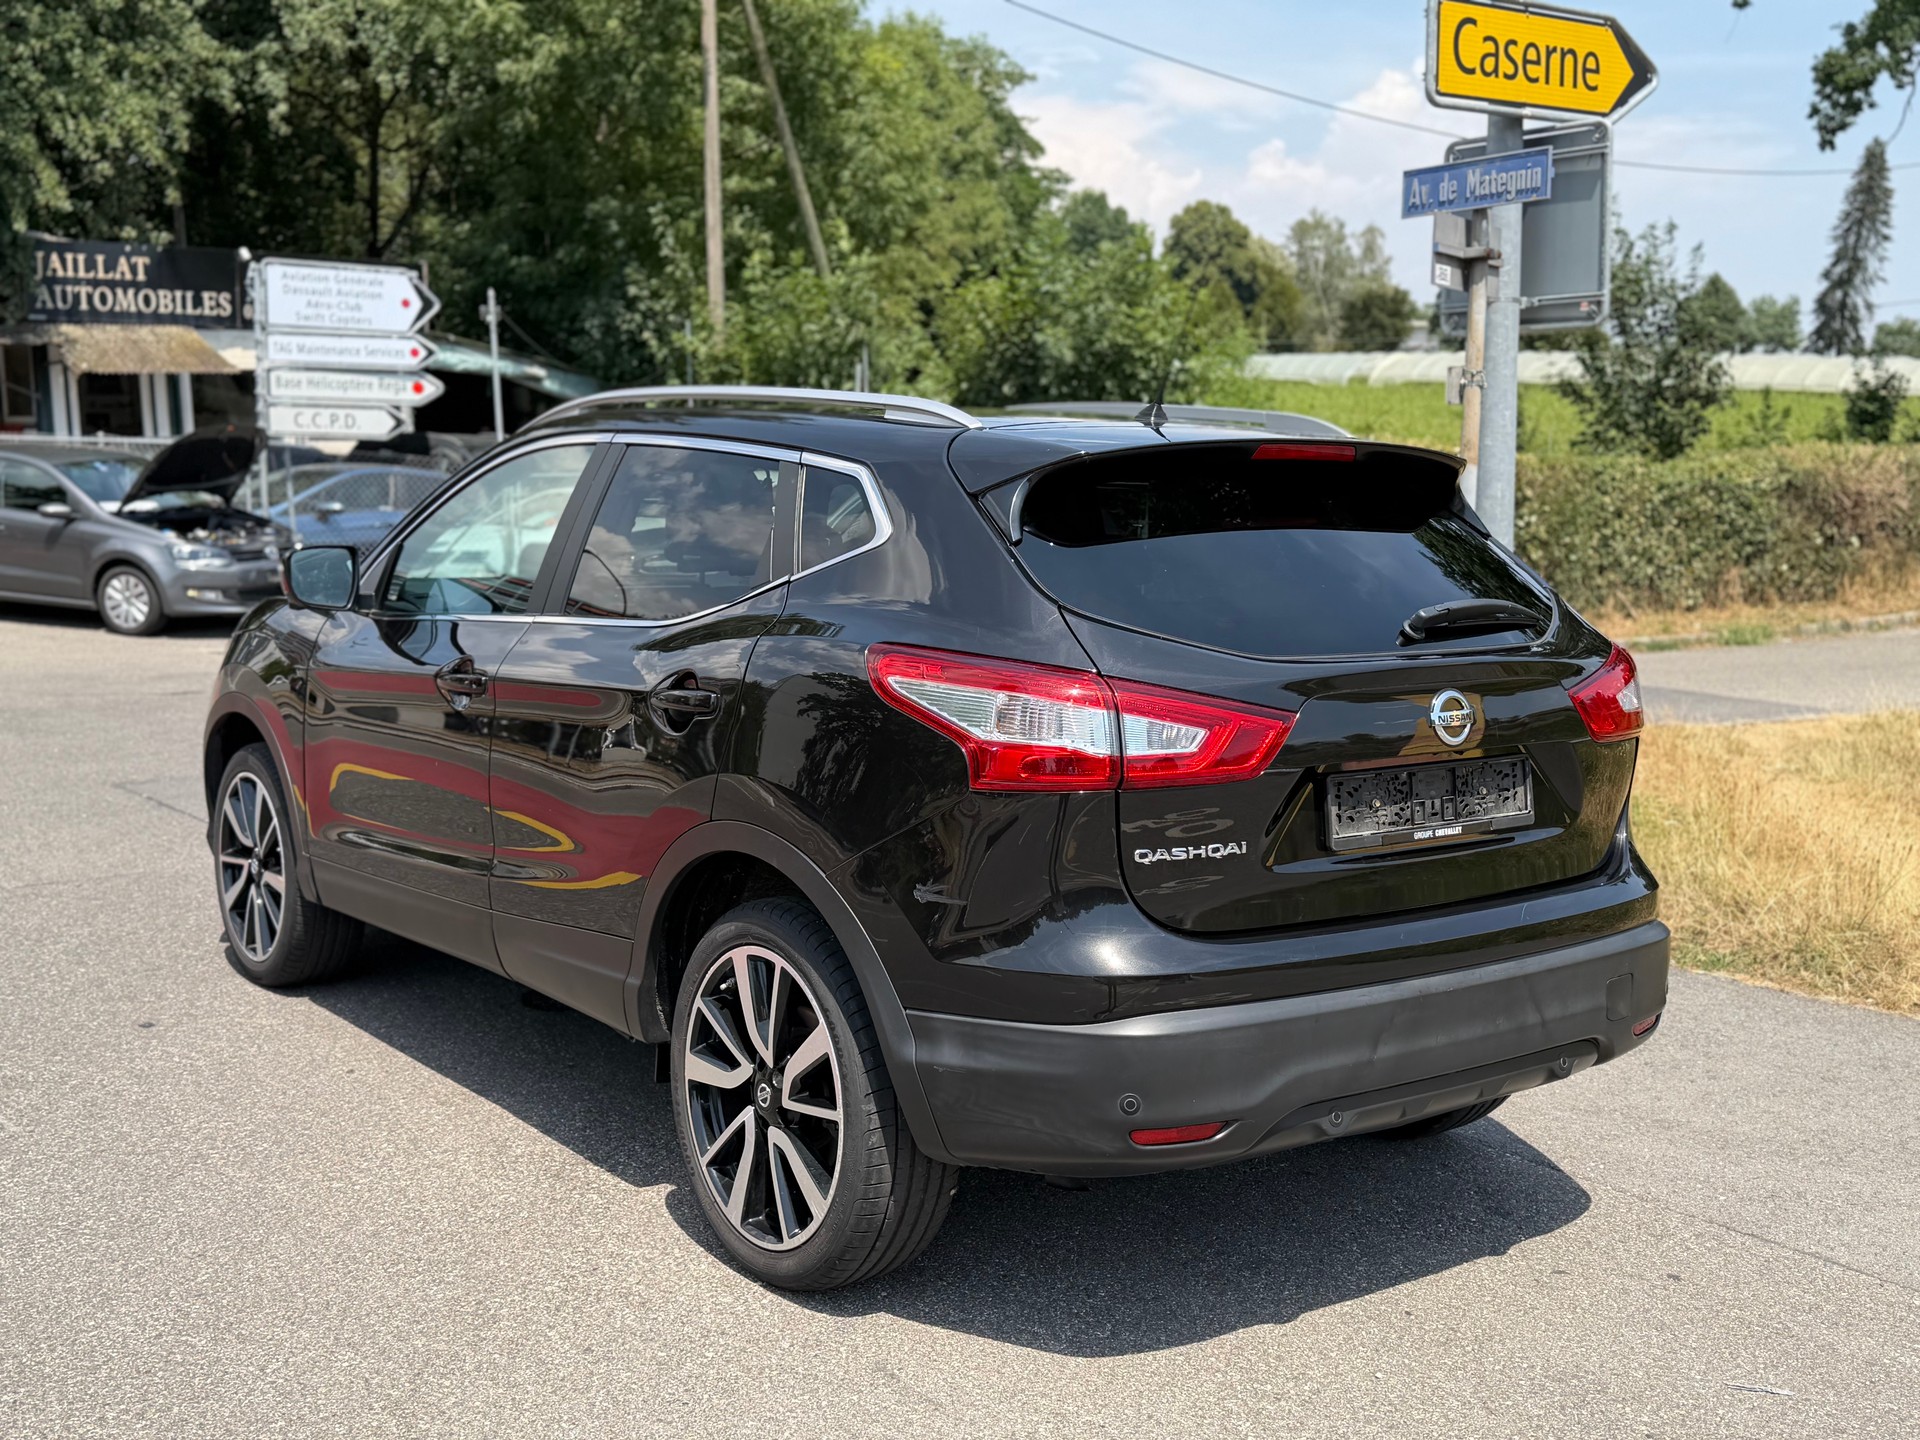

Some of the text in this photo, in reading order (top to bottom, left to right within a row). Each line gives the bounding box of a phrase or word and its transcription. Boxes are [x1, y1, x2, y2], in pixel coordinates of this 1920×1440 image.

[1453, 17, 1601, 92] Caserne
[1408, 163, 1542, 207] Av. de Mategnin
[34, 250, 151, 282] JAILLAT
[281, 270, 330, 282] Aviation
[34, 284, 233, 318] AUTOMOBILES
[335, 287, 384, 300] Aviation
[296, 342, 361, 357] Maintenance
[364, 345, 406, 359] Services
[275, 375, 302, 389] Base
[293, 412, 361, 431] C.C.P.D.
[1437, 711, 1472, 724] NISSAN
[1413, 830, 1434, 840] GROUPE
[1134, 841, 1247, 865] QASHQAI
